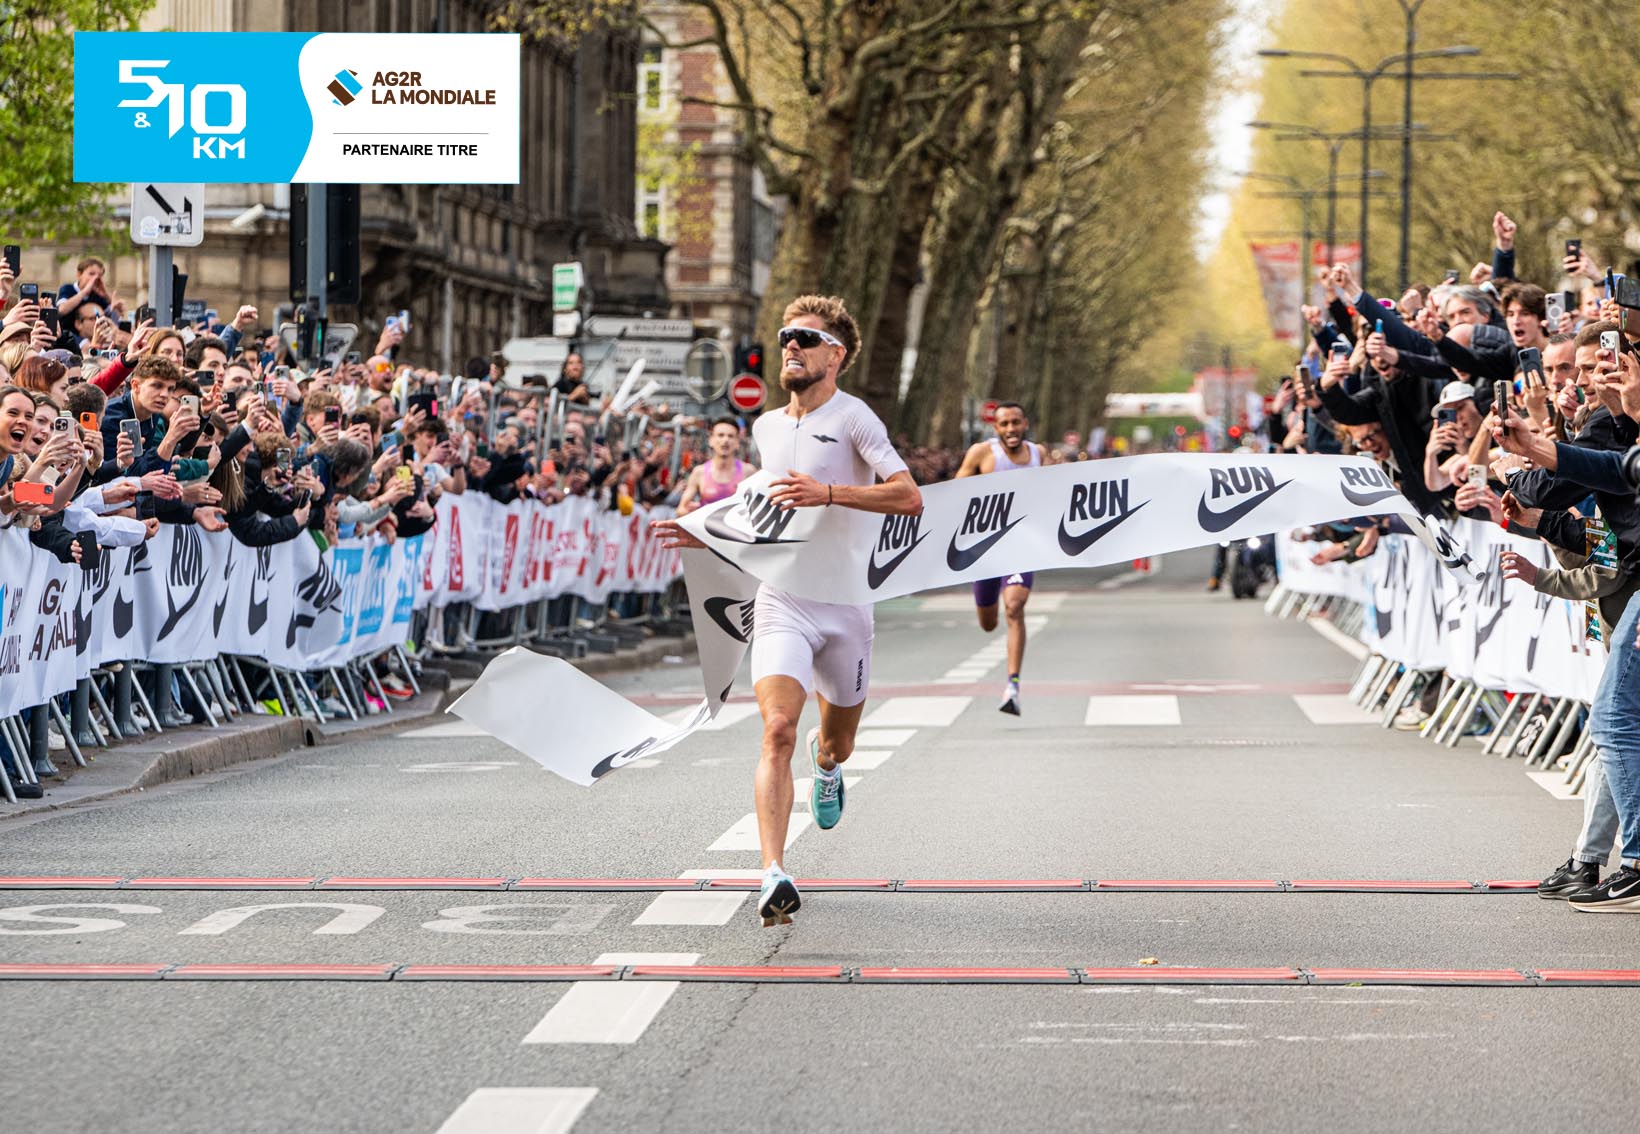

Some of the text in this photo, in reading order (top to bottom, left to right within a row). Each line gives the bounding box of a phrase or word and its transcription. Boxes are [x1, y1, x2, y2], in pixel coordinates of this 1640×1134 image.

[1069, 479, 1129, 522] RUN
[1210, 467, 1275, 500] RUN
[878, 507, 924, 552] RUN
[960, 492, 1015, 536] RUN
